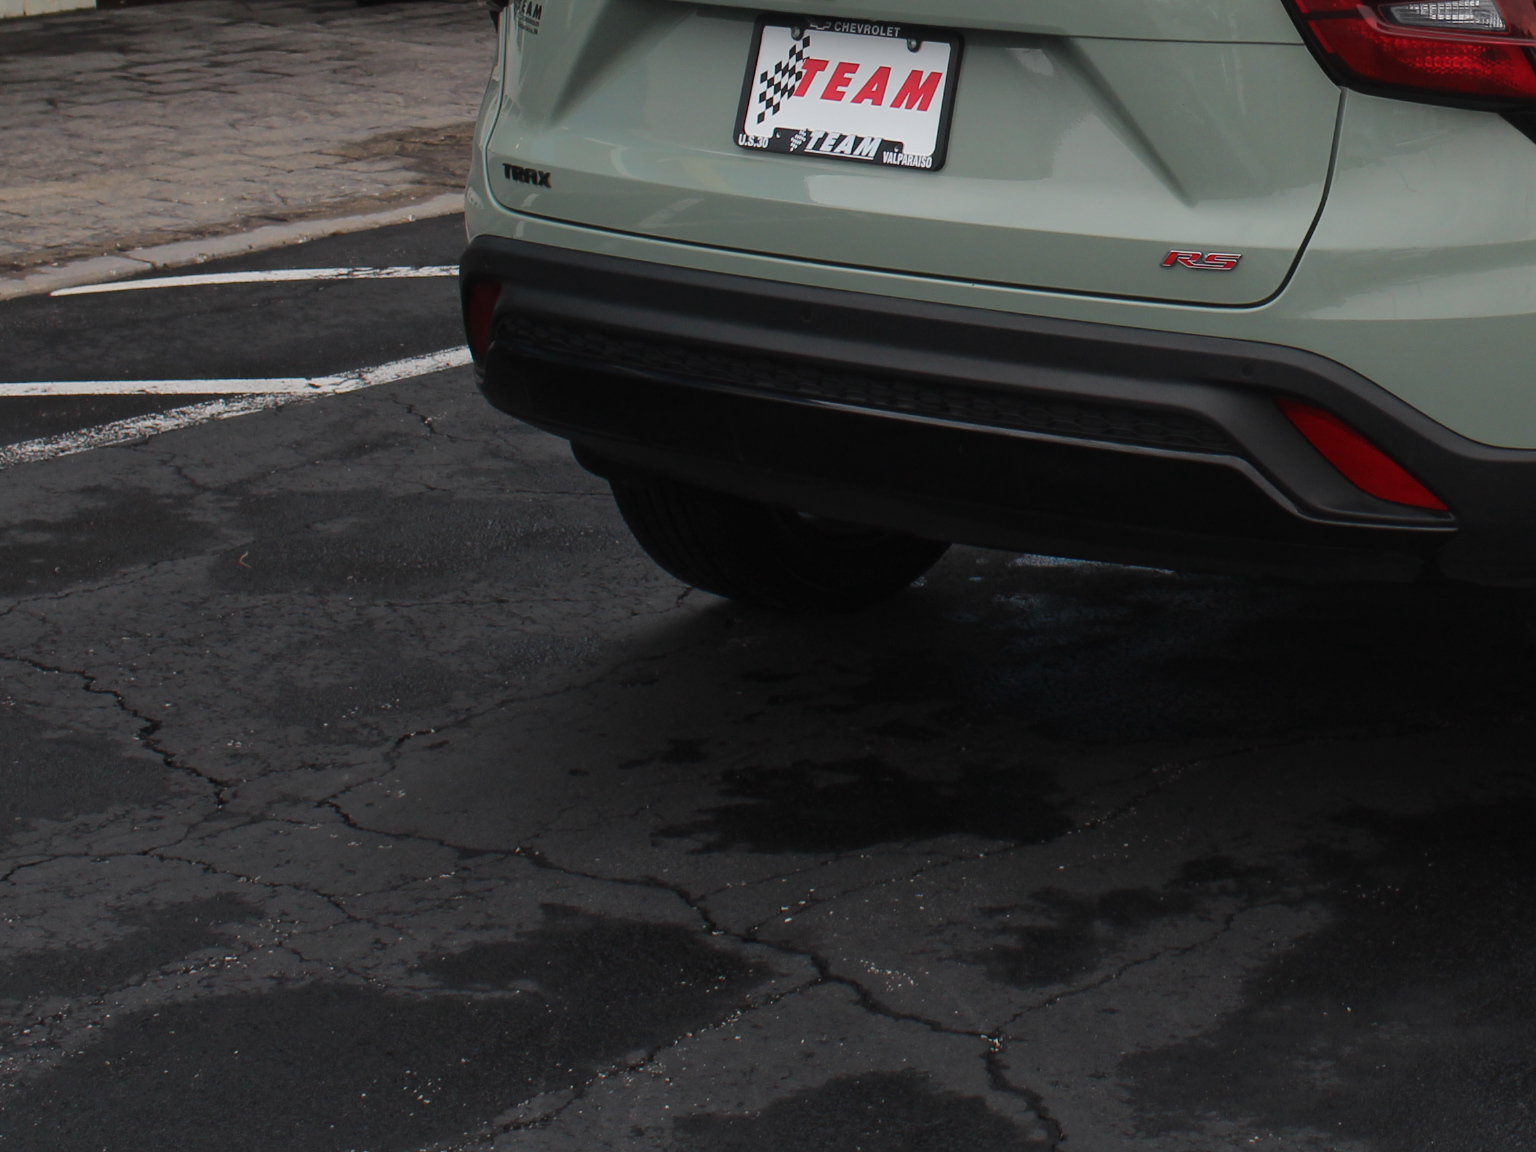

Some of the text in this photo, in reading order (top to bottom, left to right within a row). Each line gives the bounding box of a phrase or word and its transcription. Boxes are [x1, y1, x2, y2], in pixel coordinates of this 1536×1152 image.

[833, 21, 901, 38] CHEVROLET
[792, 58, 943, 112] TEAM
[804, 130, 883, 159] TEAM
[882, 150, 933, 169] VALPARAISO
[1161, 249, 1242, 271] RS
